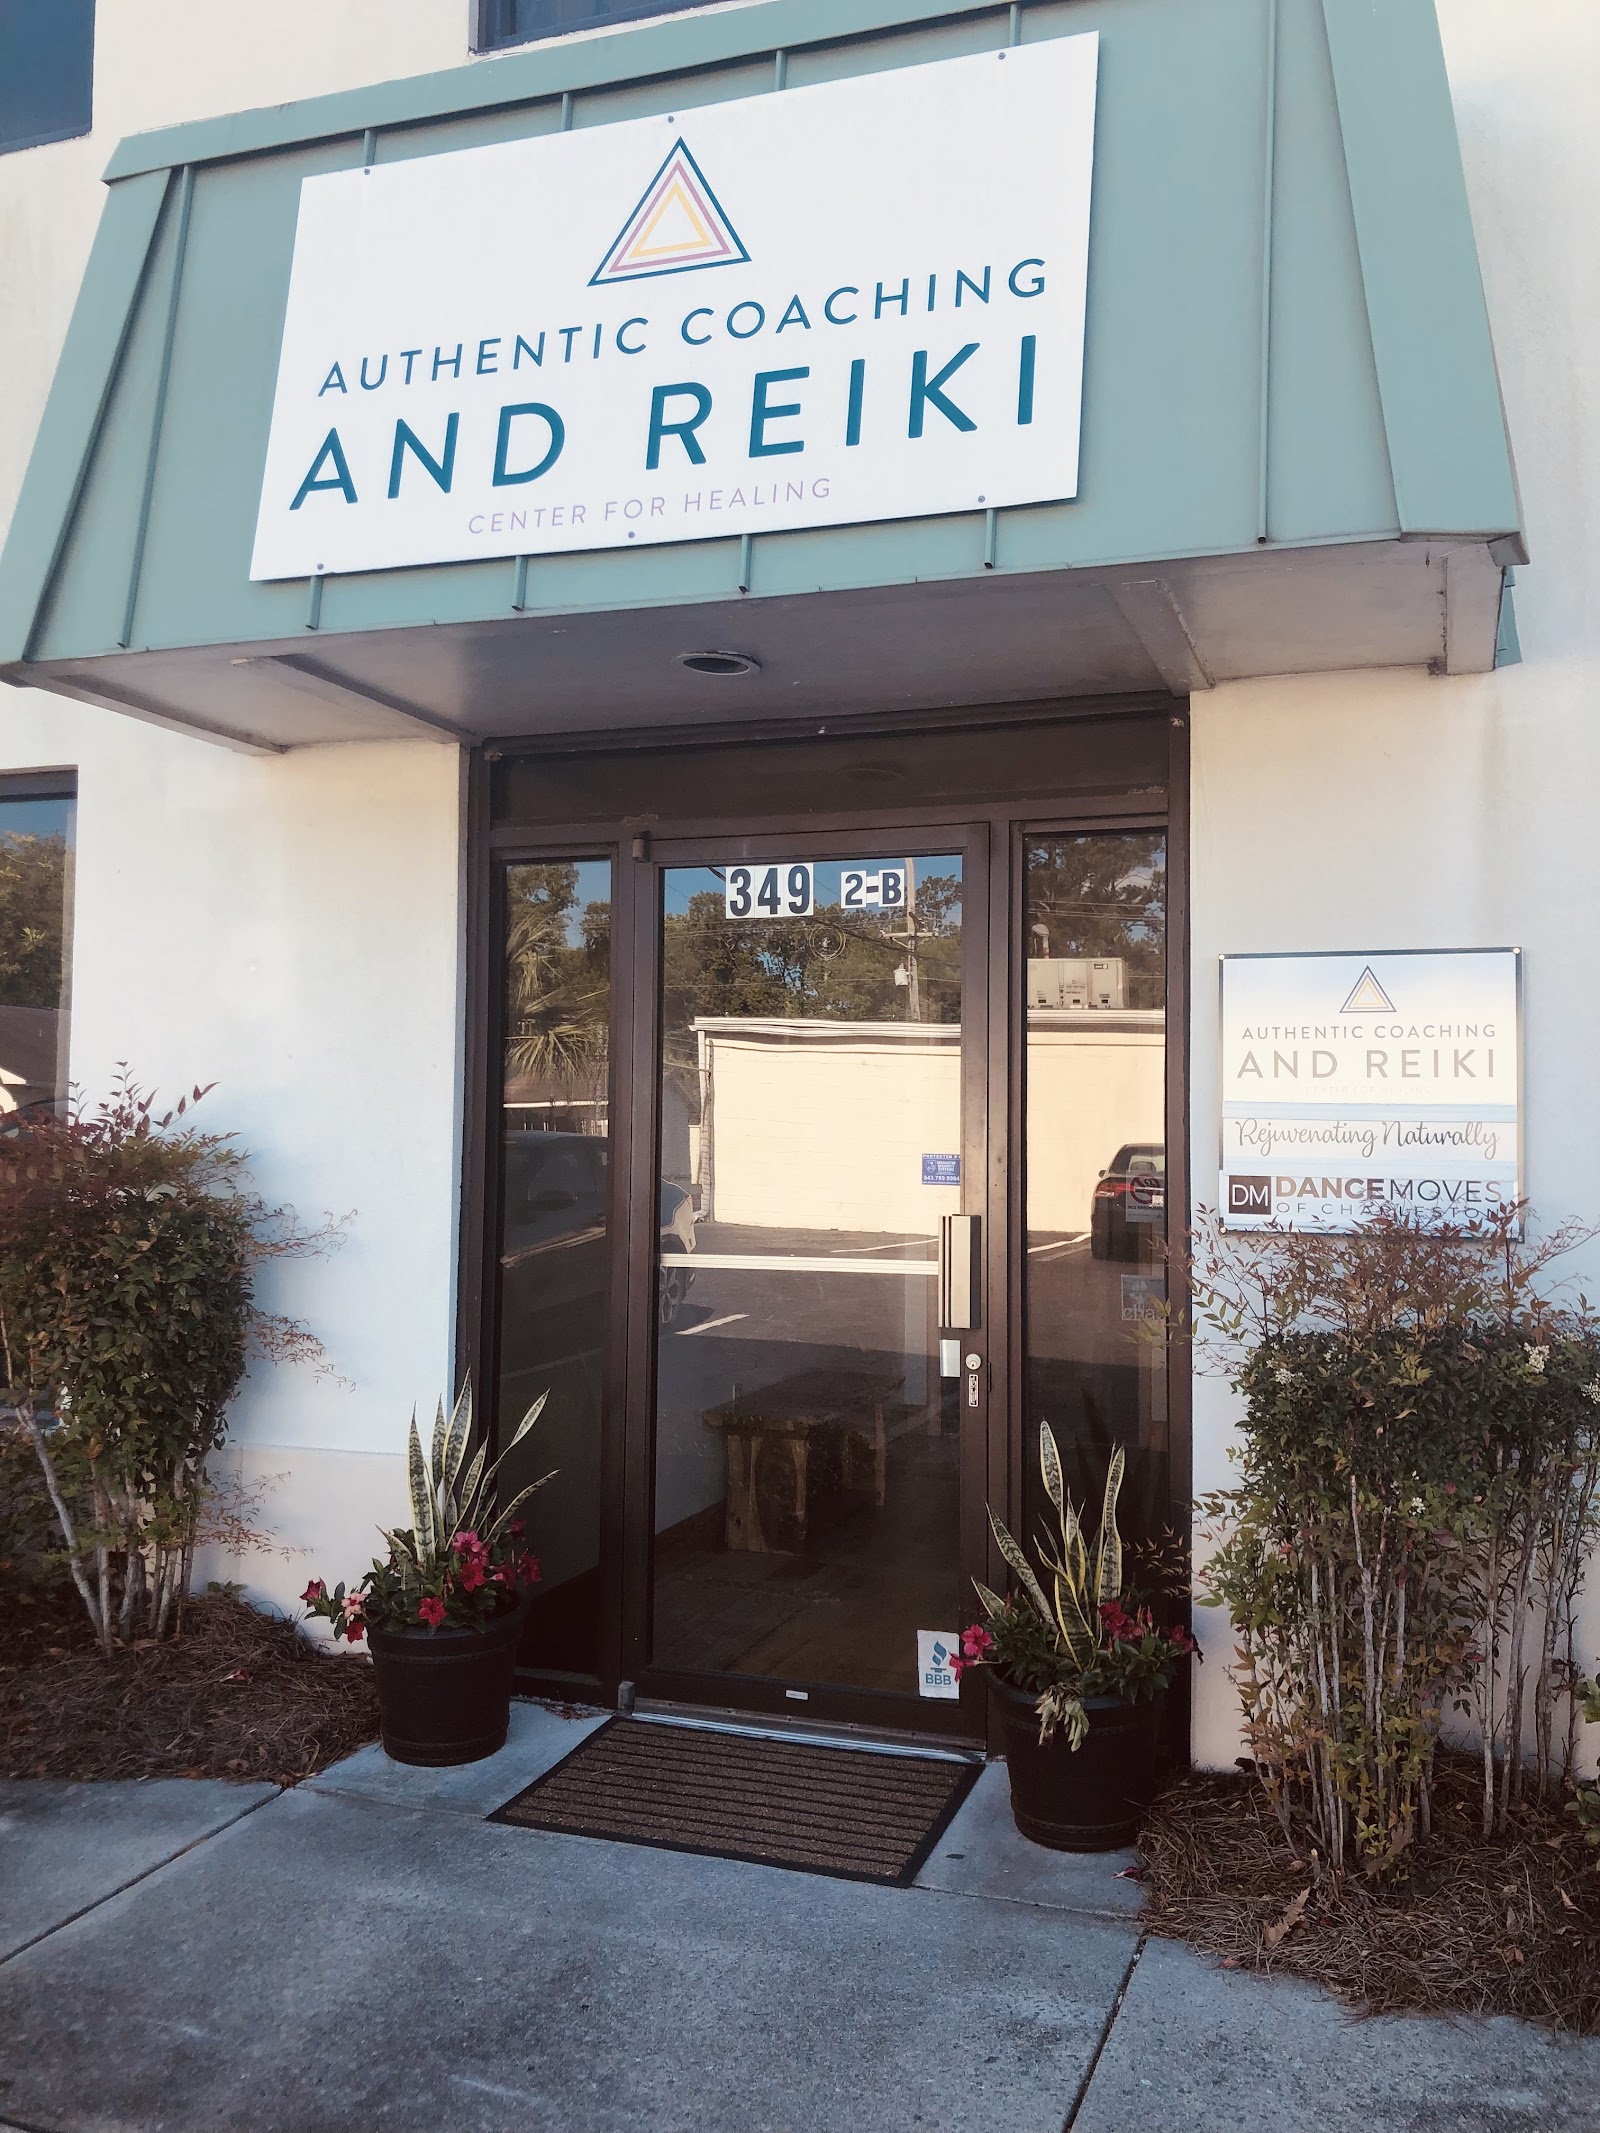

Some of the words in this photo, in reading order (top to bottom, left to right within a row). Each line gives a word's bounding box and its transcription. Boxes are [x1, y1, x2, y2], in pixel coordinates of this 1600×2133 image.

[318, 317, 648, 397] AUTHENTIC
[681, 258, 1047, 345] COACHING
[290, 402, 565, 511] AND
[646, 334, 1037, 470] REIKI
[468, 503, 586, 535] CENTER
[604, 494, 666, 520] FOR
[684, 477, 832, 513] HEALING
[729, 865, 811, 916] 349
[845, 872, 902, 906] 2-B
[1242, 1025, 1364, 1040] AUTHENTIC
[1374, 1024, 1496, 1039] COACHING
[1237, 1050, 1338, 1078] AND
[1366, 1049, 1495, 1078] REIKI
[1235, 1118, 1378, 1158] Rejuvenating
[1382, 1120, 1500, 1160] Naturally
[1231, 1184, 1269, 1207] DM
[1276, 1202, 1306, 1213] OF
[925, 1673, 952, 1686] BBB
